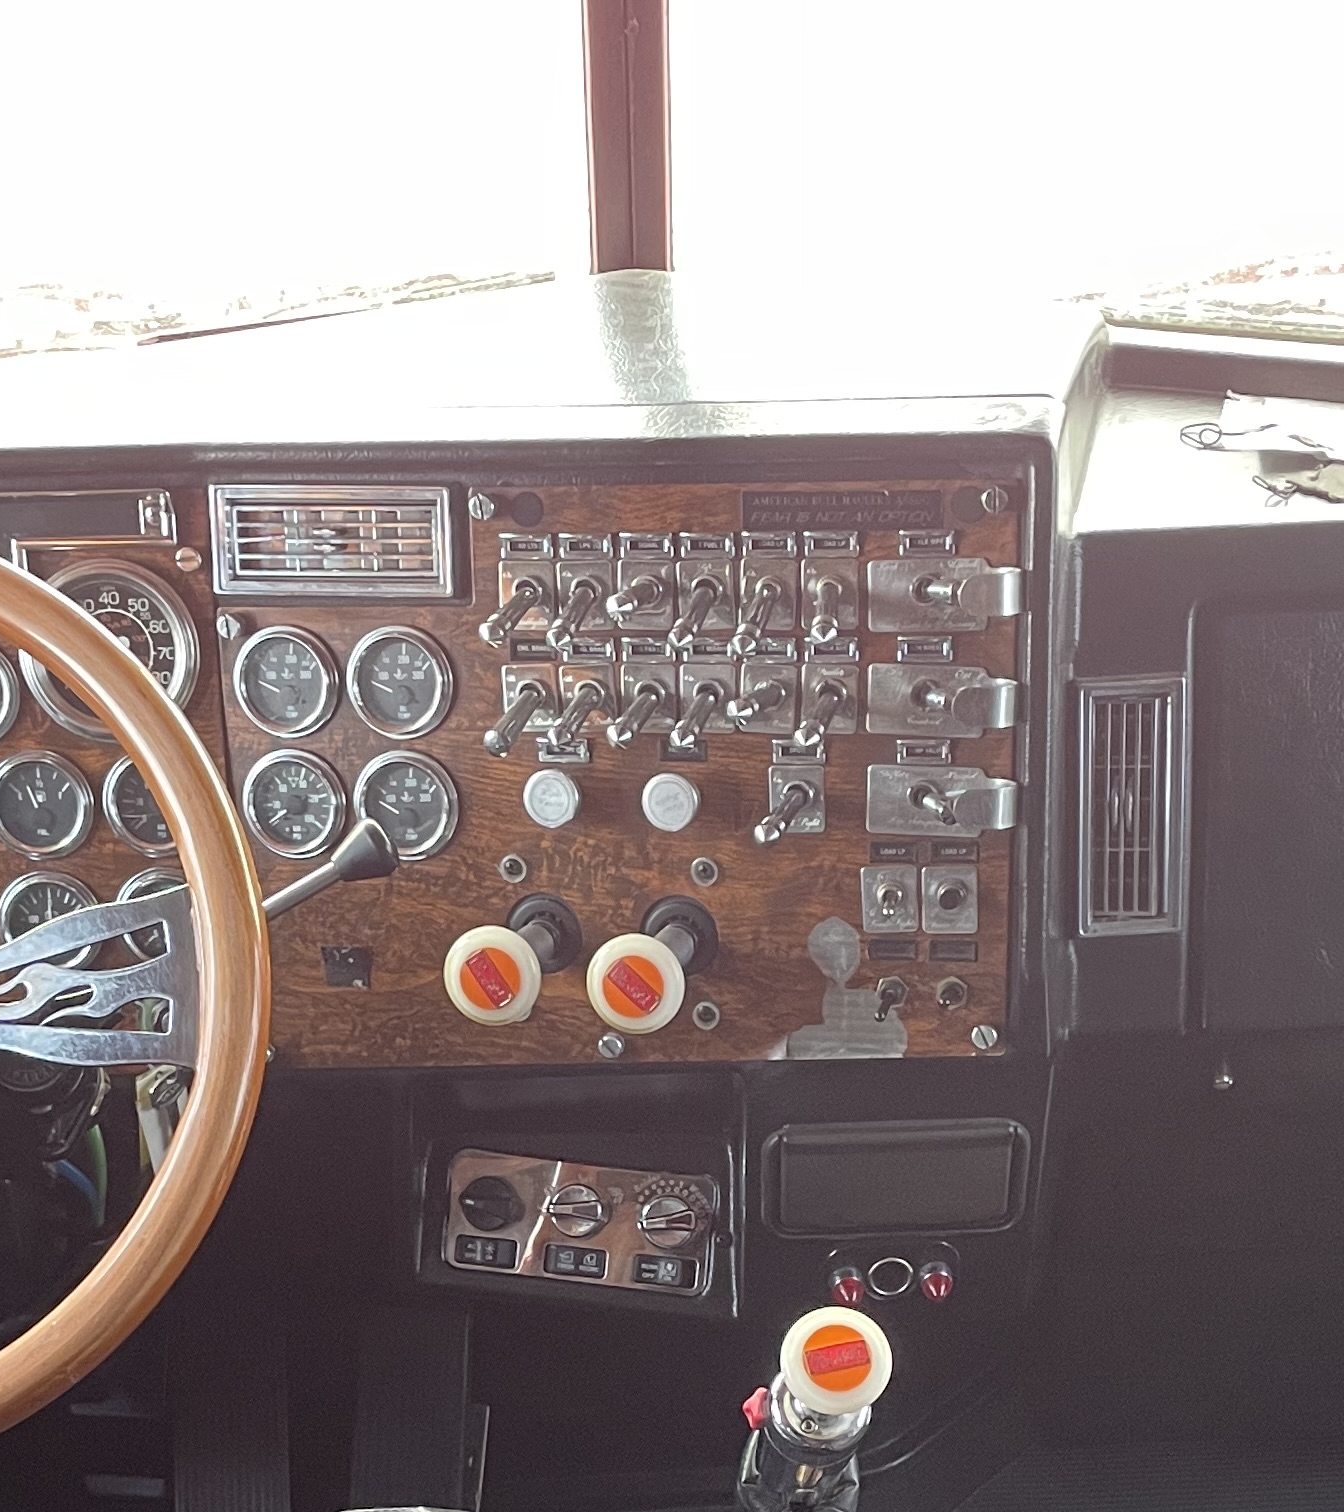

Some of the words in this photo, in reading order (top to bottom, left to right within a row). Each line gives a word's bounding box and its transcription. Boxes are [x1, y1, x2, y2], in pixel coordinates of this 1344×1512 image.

[815, 511, 848, 523] NOT
[98, 591, 120, 605] 40
[127, 598, 149, 612] 50
[149, 620, 170, 634] 60
[157, 646, 174, 660] 70
[880, 847, 896, 855] LOAD
